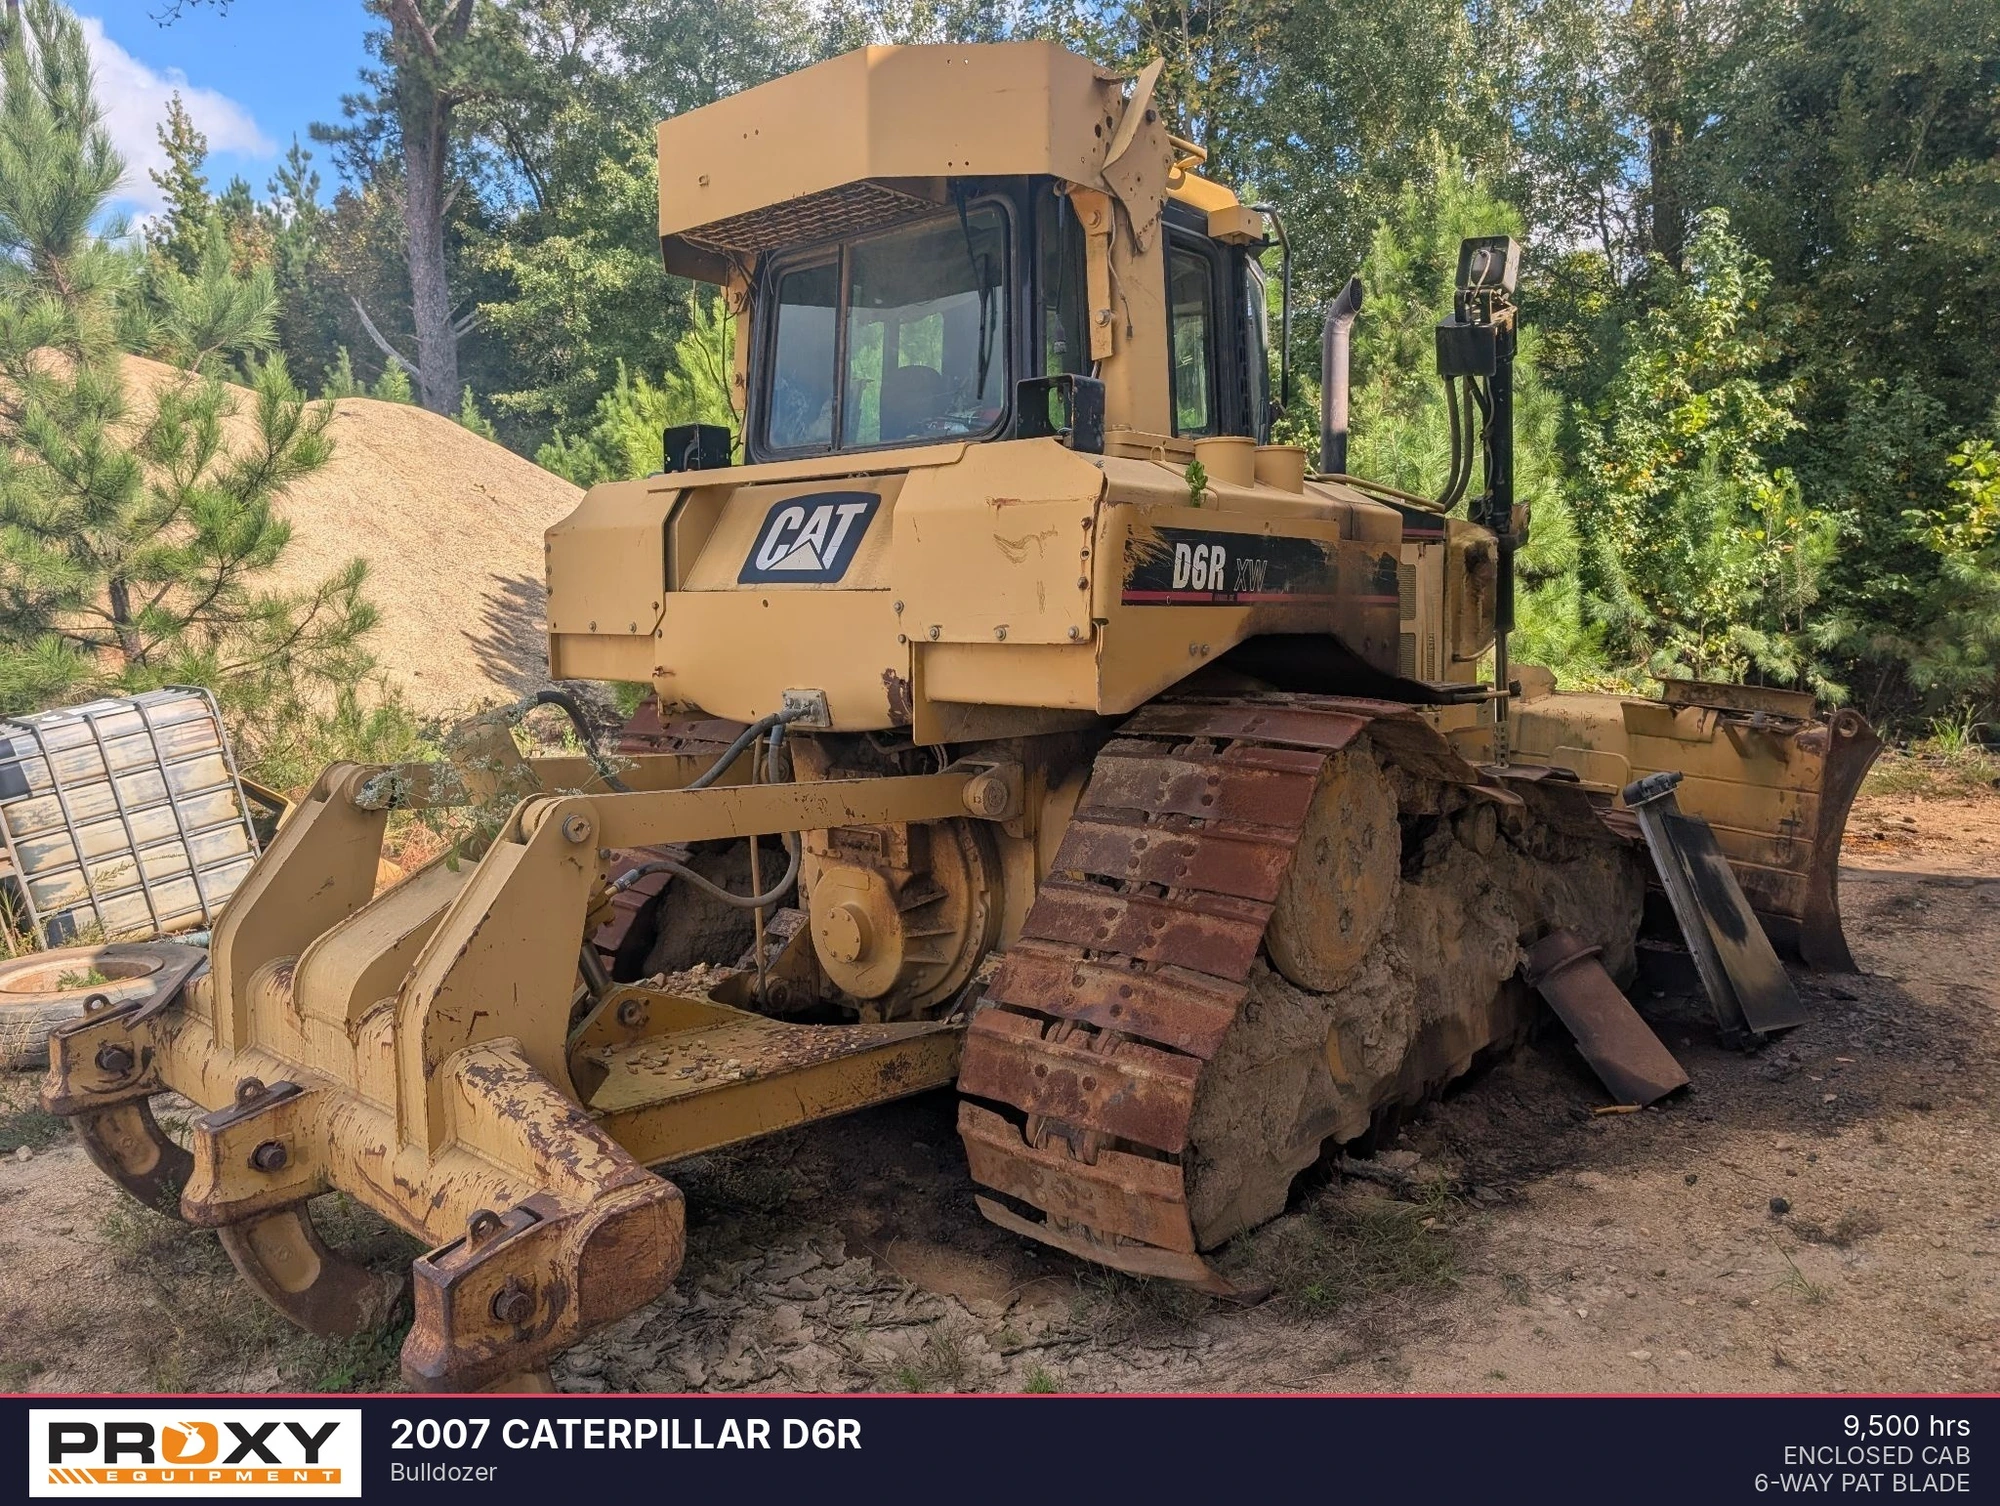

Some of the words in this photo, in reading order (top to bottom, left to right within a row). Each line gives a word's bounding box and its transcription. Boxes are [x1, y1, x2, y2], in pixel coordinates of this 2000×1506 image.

[755, 503, 868, 571] CAT
[1172, 543, 1226, 591] D6R
[1233, 558, 1268, 592] XW
